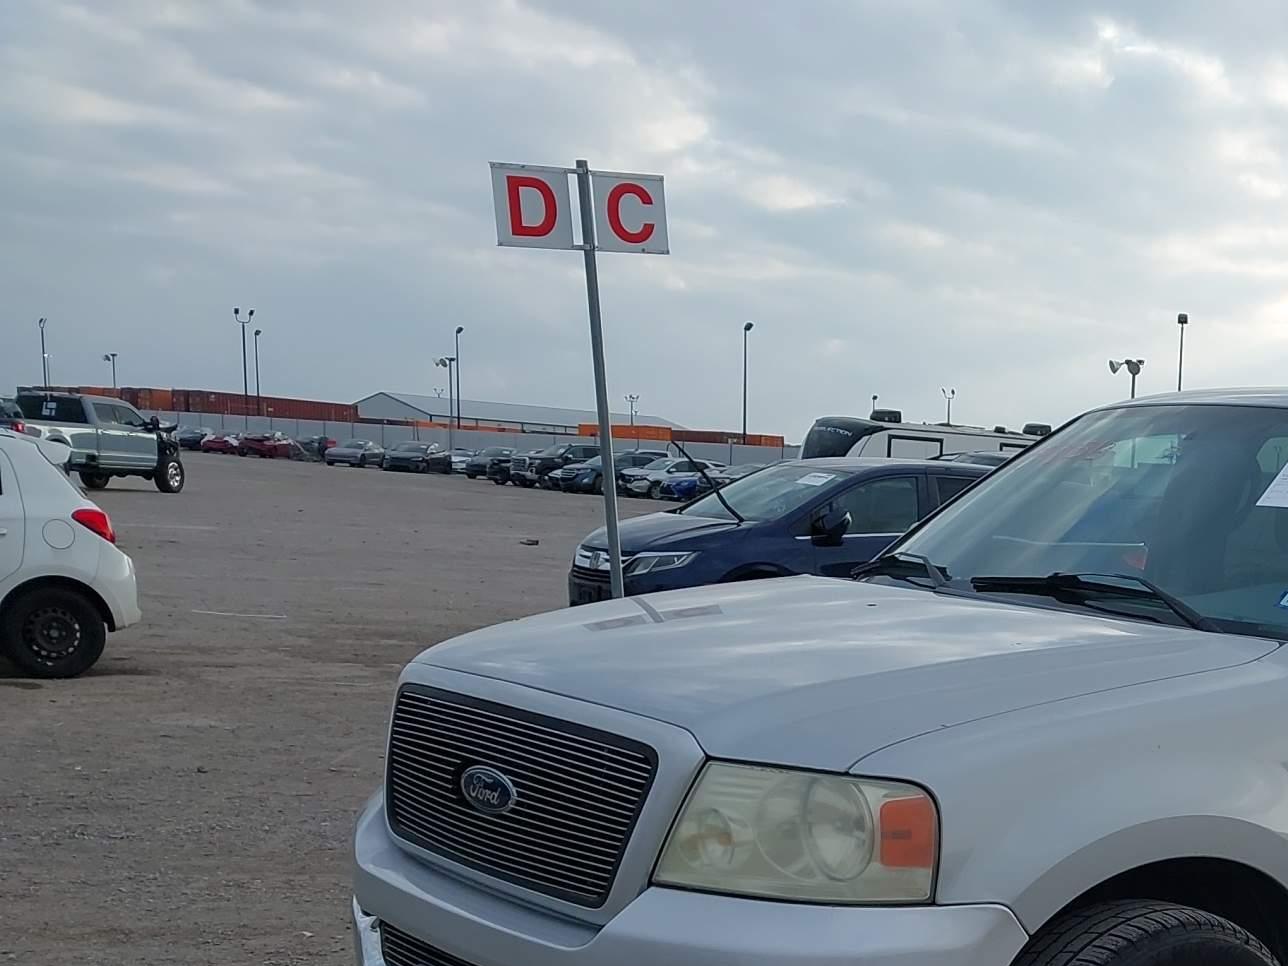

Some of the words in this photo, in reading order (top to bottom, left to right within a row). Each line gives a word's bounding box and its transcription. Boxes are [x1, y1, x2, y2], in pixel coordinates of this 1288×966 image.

[505, 175, 557, 237] D
[606, 182, 655, 245] C
[470, 773, 501, 805] Ford
